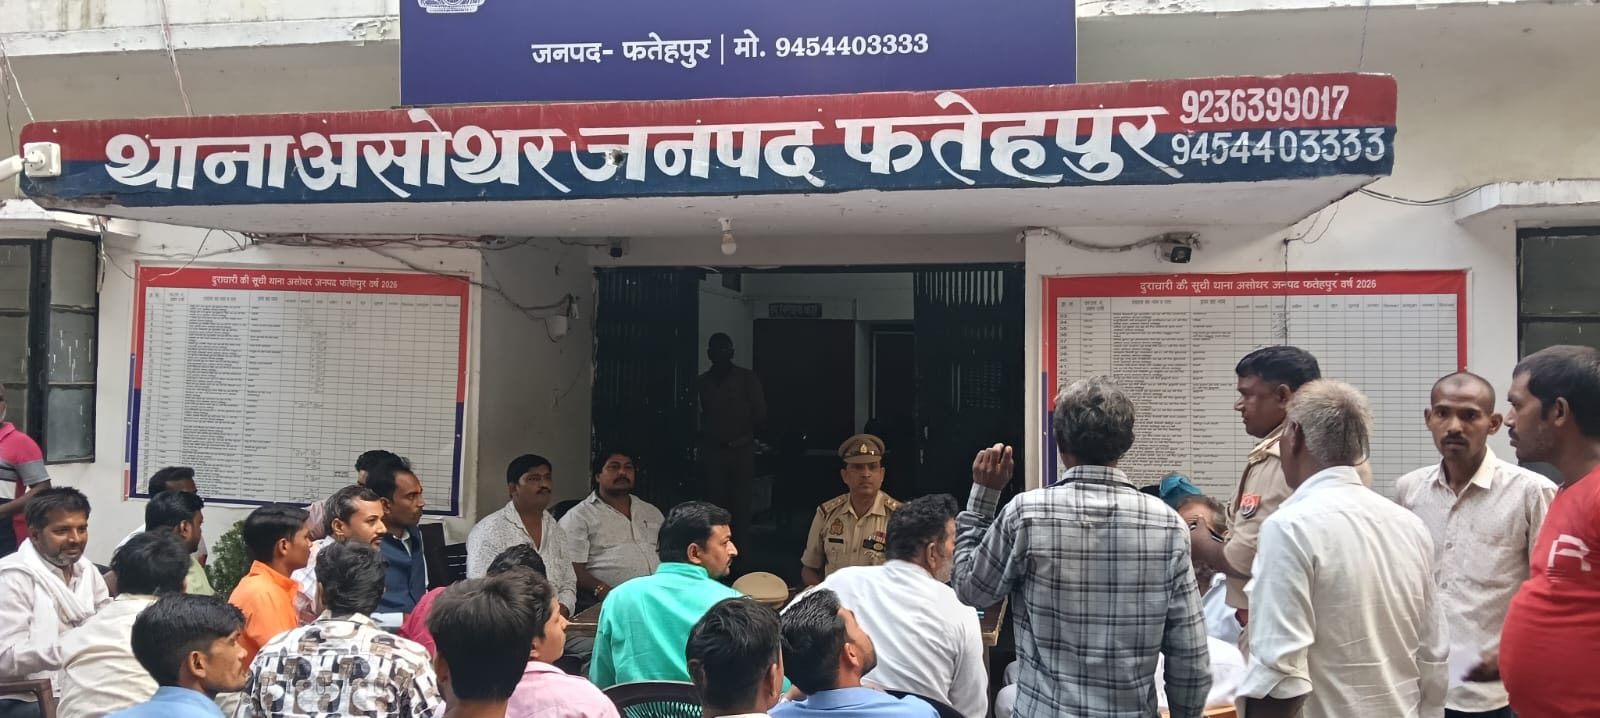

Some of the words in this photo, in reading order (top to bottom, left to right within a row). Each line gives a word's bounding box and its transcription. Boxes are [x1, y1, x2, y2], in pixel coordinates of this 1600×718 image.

[622, 32, 711, 69] फतेहपुर
[733, 29, 766, 59] मो.
[775, 33, 929, 58] 9454403333
[1181, 85, 1350, 124] 9236399017
[571, 120, 825, 188] जनपद
[836, 91, 1184, 182] फतेहपुर
[1172, 126, 1386, 166] 9454403333
[1140, 279, 1173, 294] दुराचारी
[1191, 280, 1210, 294] सूची
[1213, 281, 1233, 290] थाना
[1236, 279, 1269, 290] असोथर
[1302, 279, 1338, 293] फतेहपुर
[1340, 277, 1354, 289] वर्ष
[1356, 279, 1377, 289] 2026
